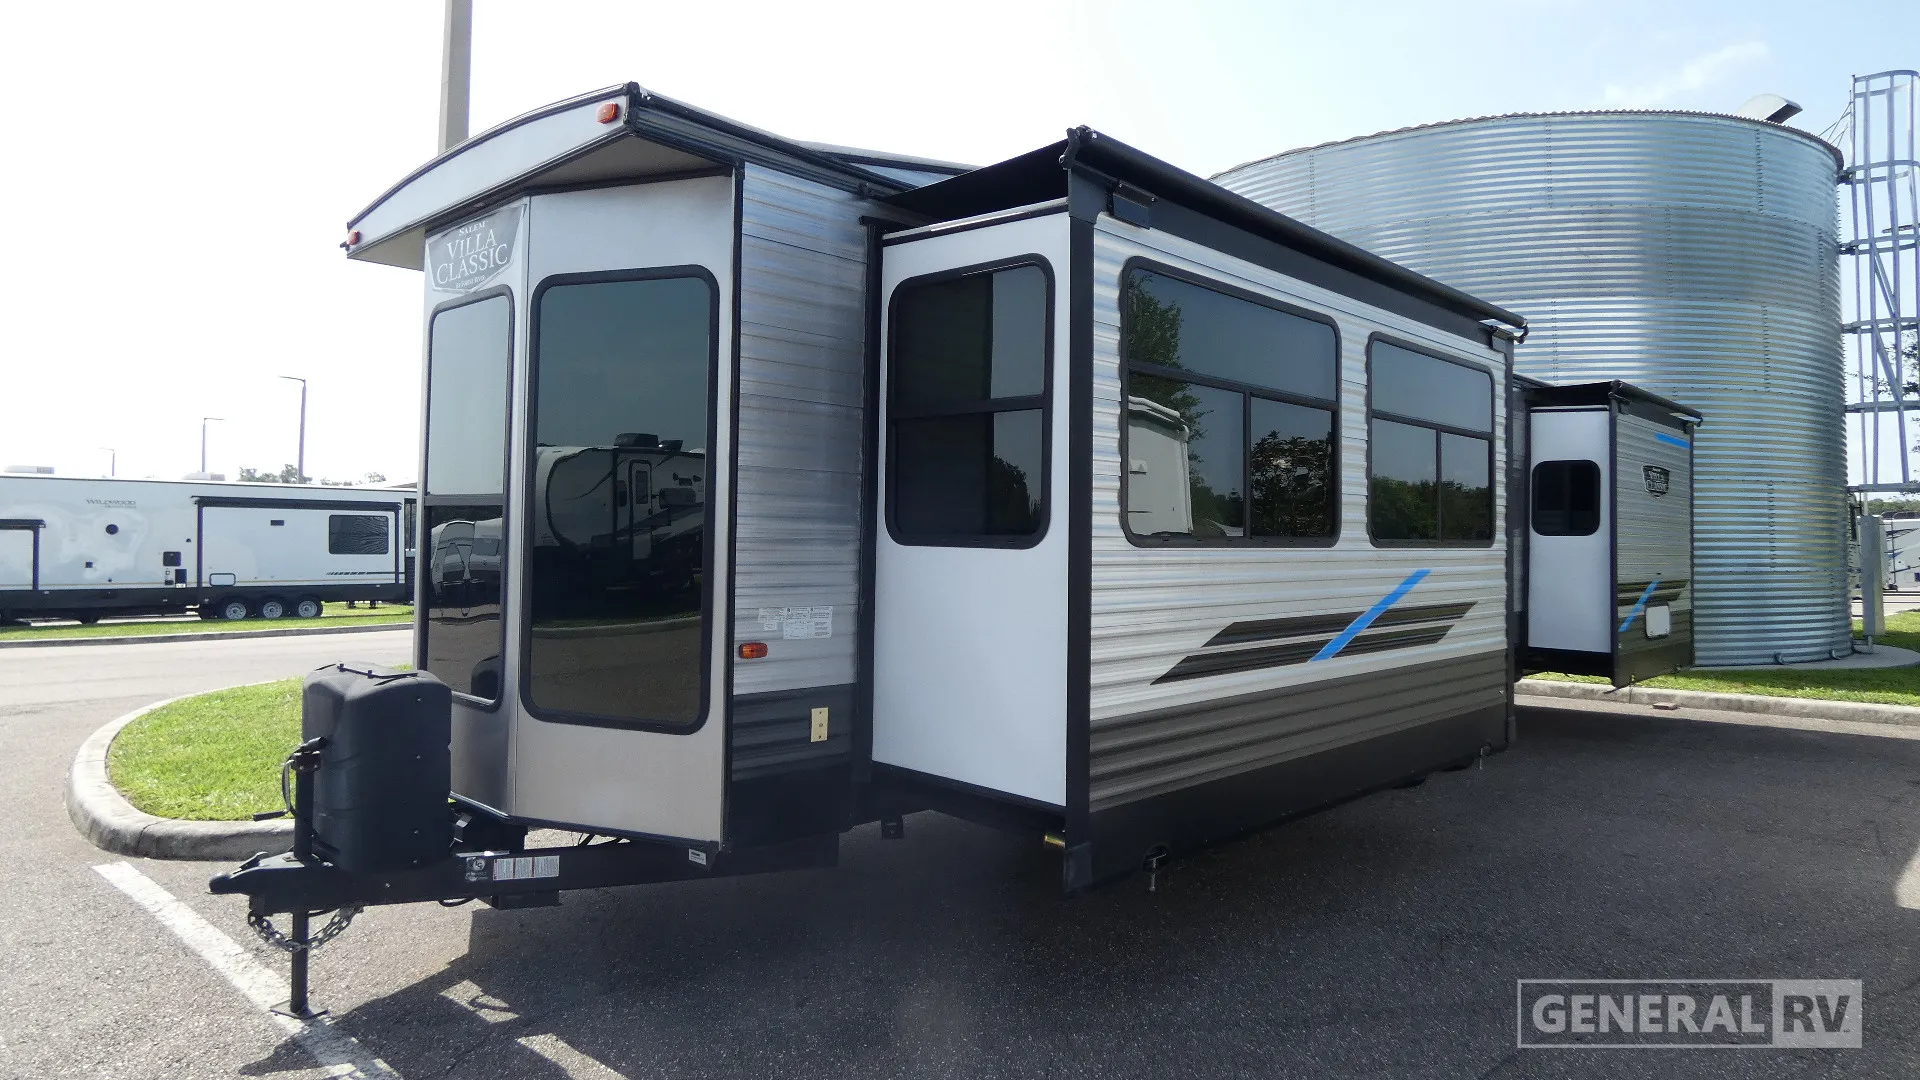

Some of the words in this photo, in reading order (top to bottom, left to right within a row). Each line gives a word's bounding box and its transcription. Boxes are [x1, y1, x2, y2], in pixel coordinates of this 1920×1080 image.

[446, 228, 497, 259] VILLA
[459, 220, 486, 236] SALEM
[436, 243, 508, 284] CLASSIC
